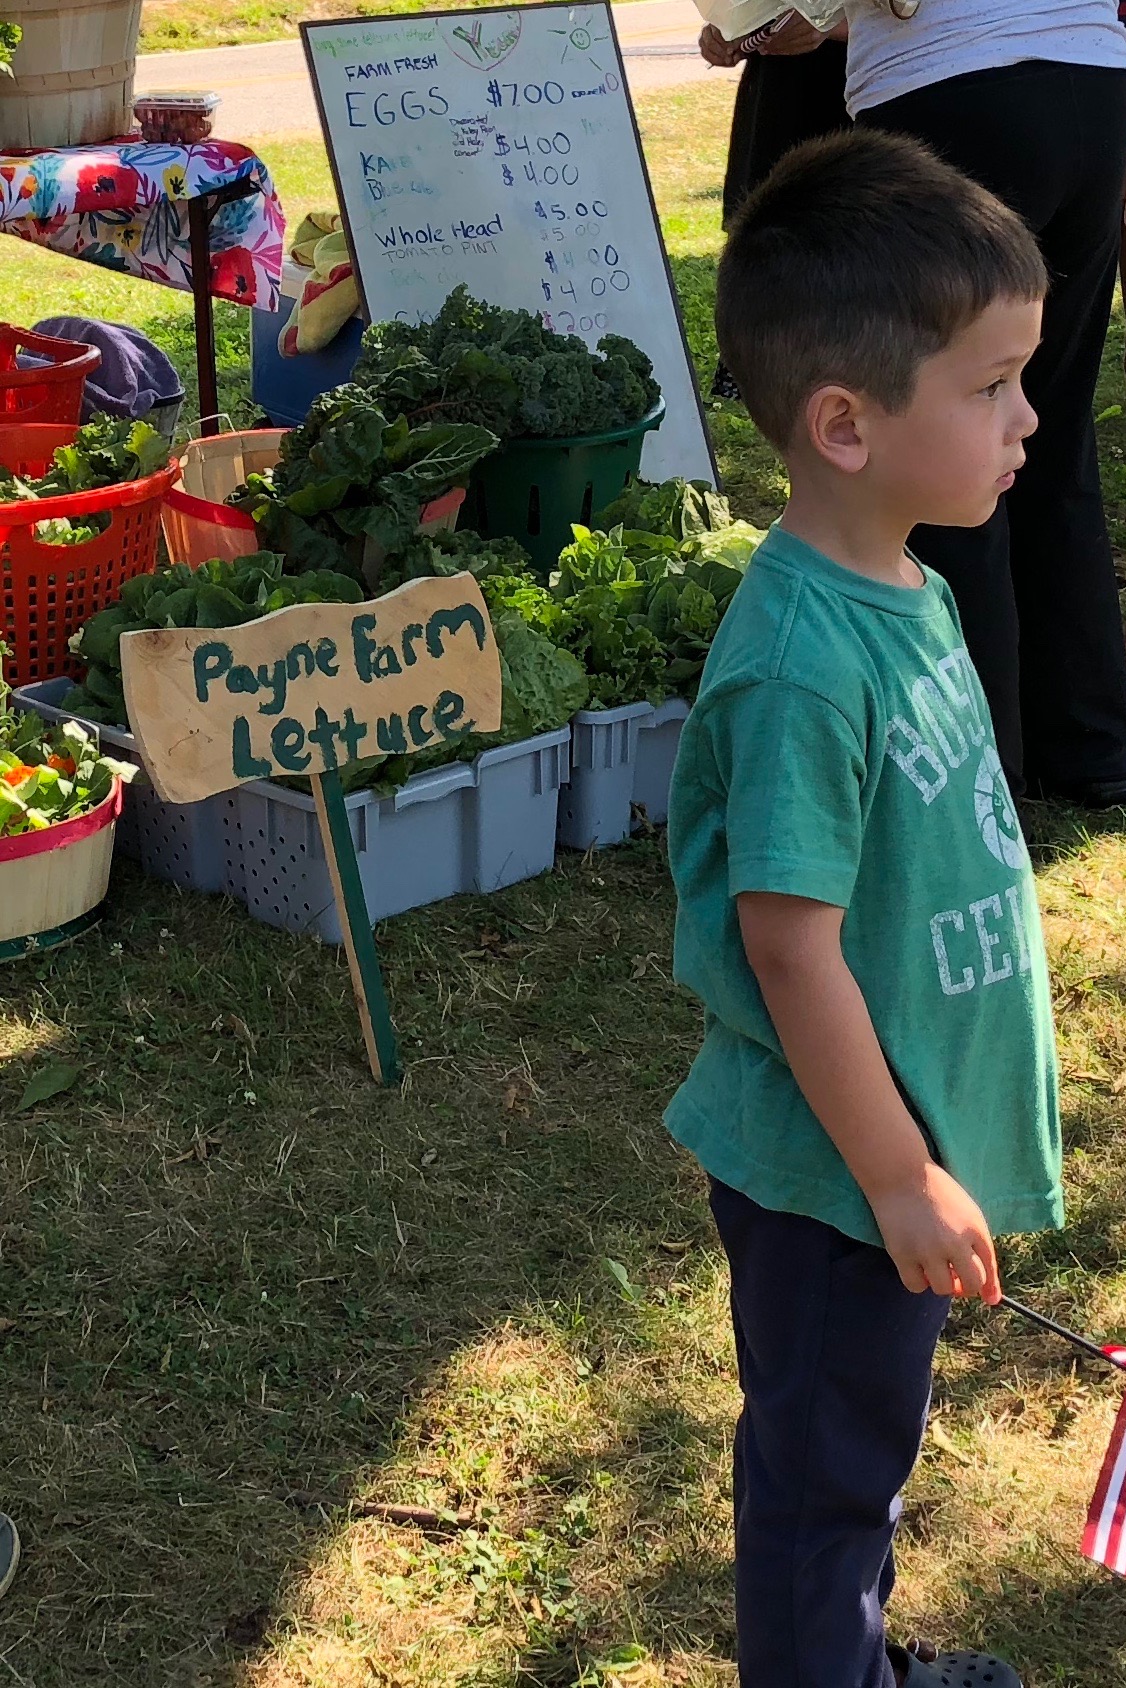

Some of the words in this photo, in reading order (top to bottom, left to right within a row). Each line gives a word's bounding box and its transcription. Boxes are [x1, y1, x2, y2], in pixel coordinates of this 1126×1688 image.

[345, 61, 392, 82] FARM
[394, 53, 438, 74] FRESH
[345, 86, 449, 127] EGGS
[375, 223, 445, 249] Whole
[451, 213, 504, 239] Head
[382, 244, 453, 263] TOMATO
[461, 241, 498, 255] PINT
[193, 637, 339, 716] Payne
[351, 603, 485, 683] Farm
[232, 690, 478, 778] Lettuce
